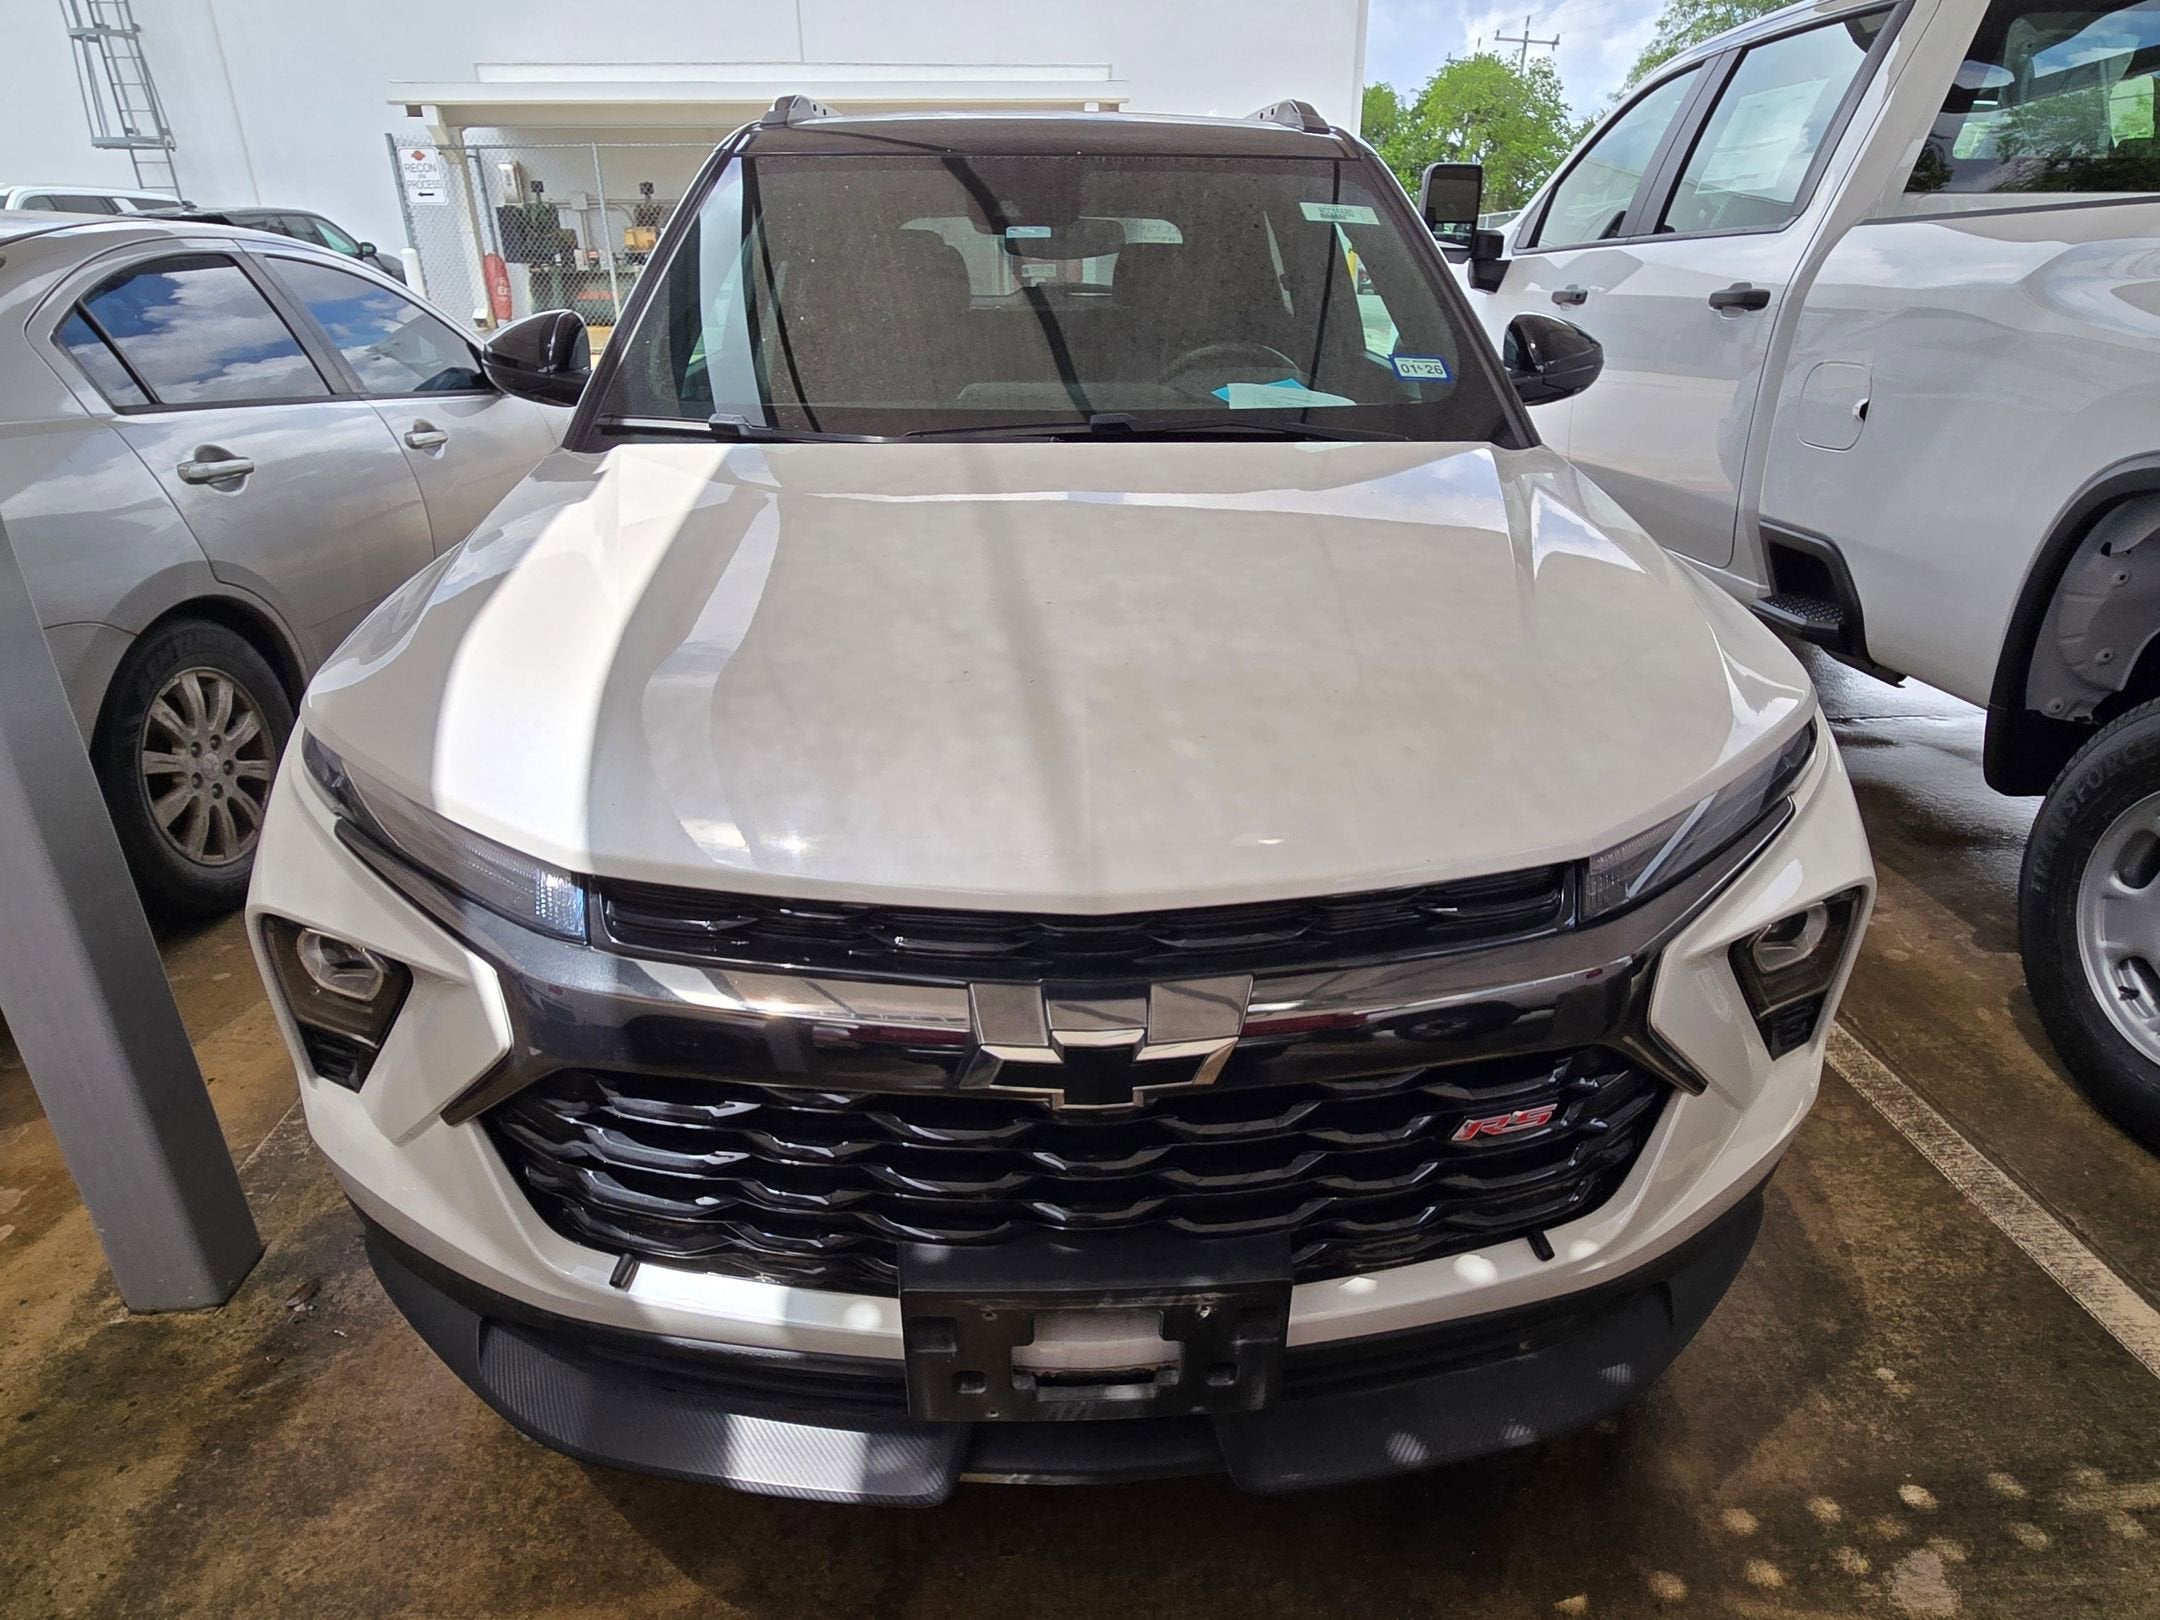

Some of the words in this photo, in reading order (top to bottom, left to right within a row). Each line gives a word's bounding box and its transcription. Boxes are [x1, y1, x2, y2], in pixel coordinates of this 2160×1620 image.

[404, 163, 437, 172] RECON
[407, 179, 442, 189] PROCESS
[1451, 1103, 1558, 1141] RS
